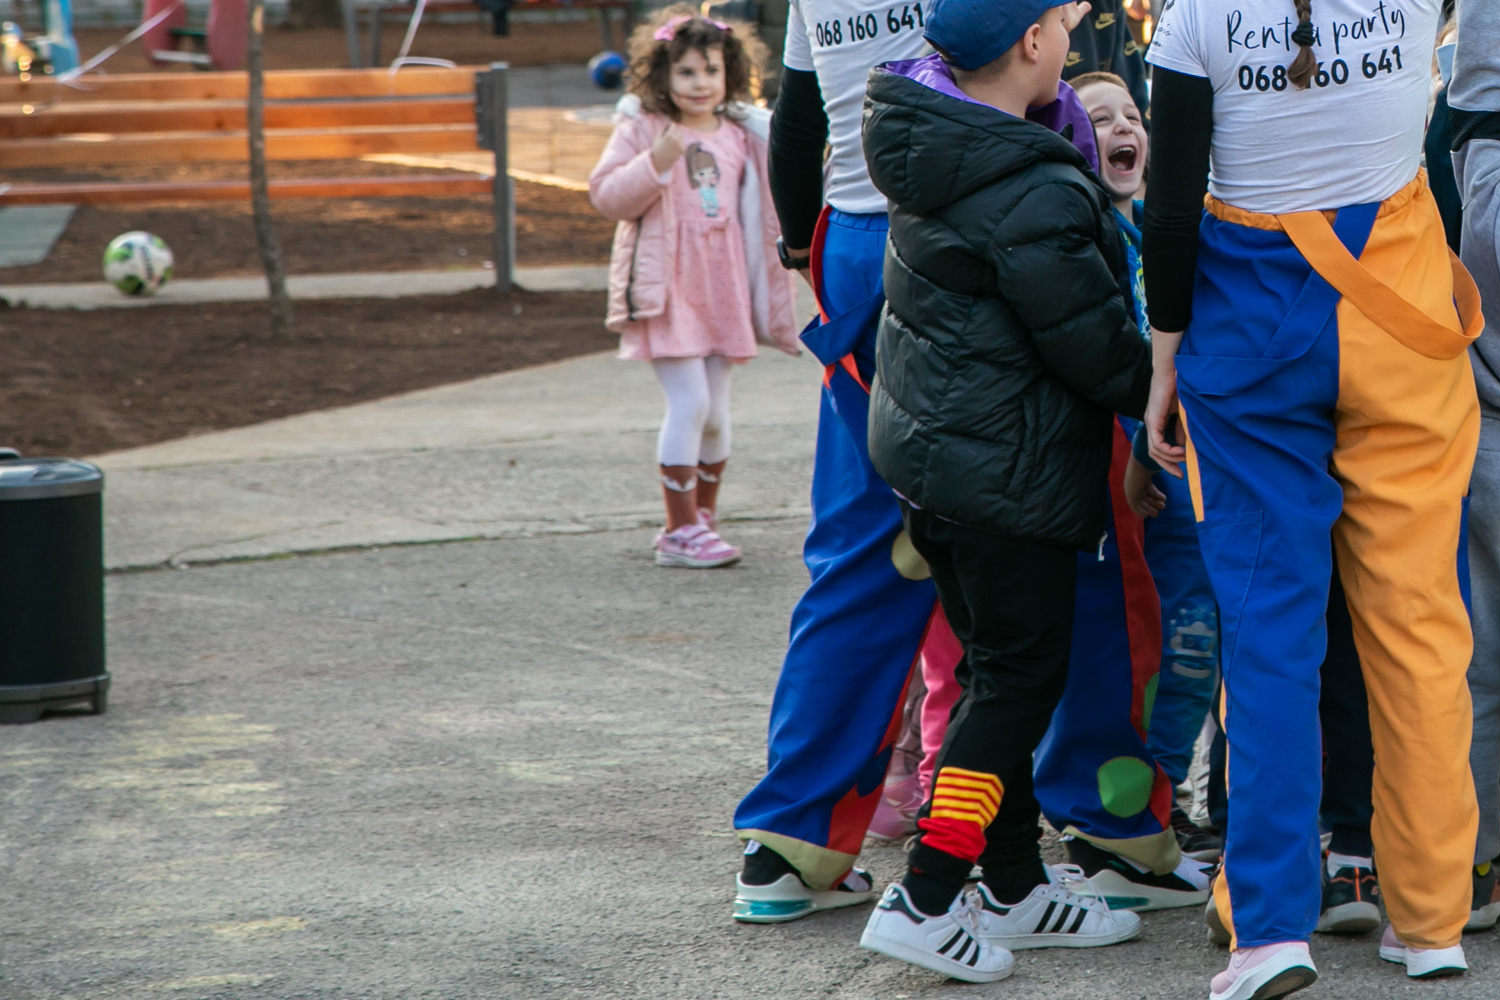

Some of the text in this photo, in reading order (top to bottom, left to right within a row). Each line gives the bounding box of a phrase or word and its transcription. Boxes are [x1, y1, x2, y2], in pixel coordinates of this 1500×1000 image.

[815, 2, 924, 47] 068 160 641
[1226, 9, 1292, 53] Rent
[1332, 0, 1406, 54] party
[1238, 44, 1403, 92] 068 60 641
